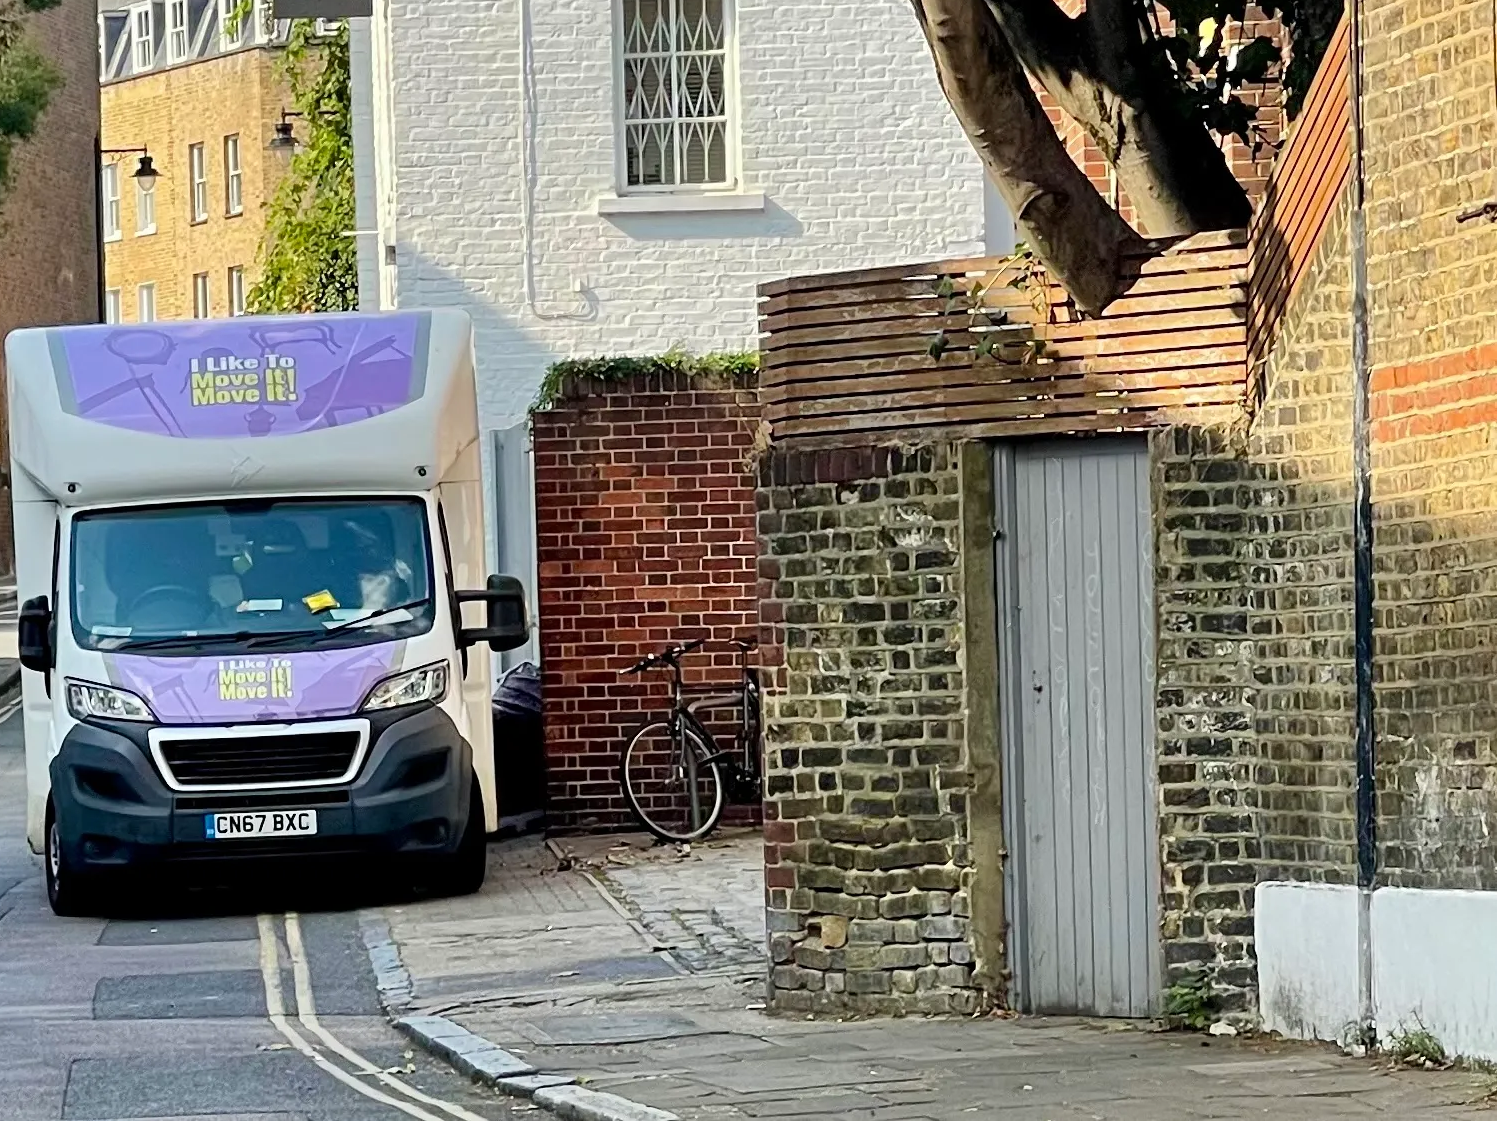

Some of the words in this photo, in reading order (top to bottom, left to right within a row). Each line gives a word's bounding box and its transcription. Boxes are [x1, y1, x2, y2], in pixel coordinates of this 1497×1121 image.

[190, 358, 199, 373] I
[206, 356, 259, 371] Like
[265, 354, 295, 368] To
[191, 372, 259, 388] Move
[192, 387, 260, 405] Move
[218, 661, 225, 670] I
[229, 659, 266, 670] Like
[271, 658, 292, 668] To
[219, 669, 267, 685] Move
[220, 683, 268, 700] Move
[216, 814, 266, 834] CN67
[272, 813, 310, 831] BXC
